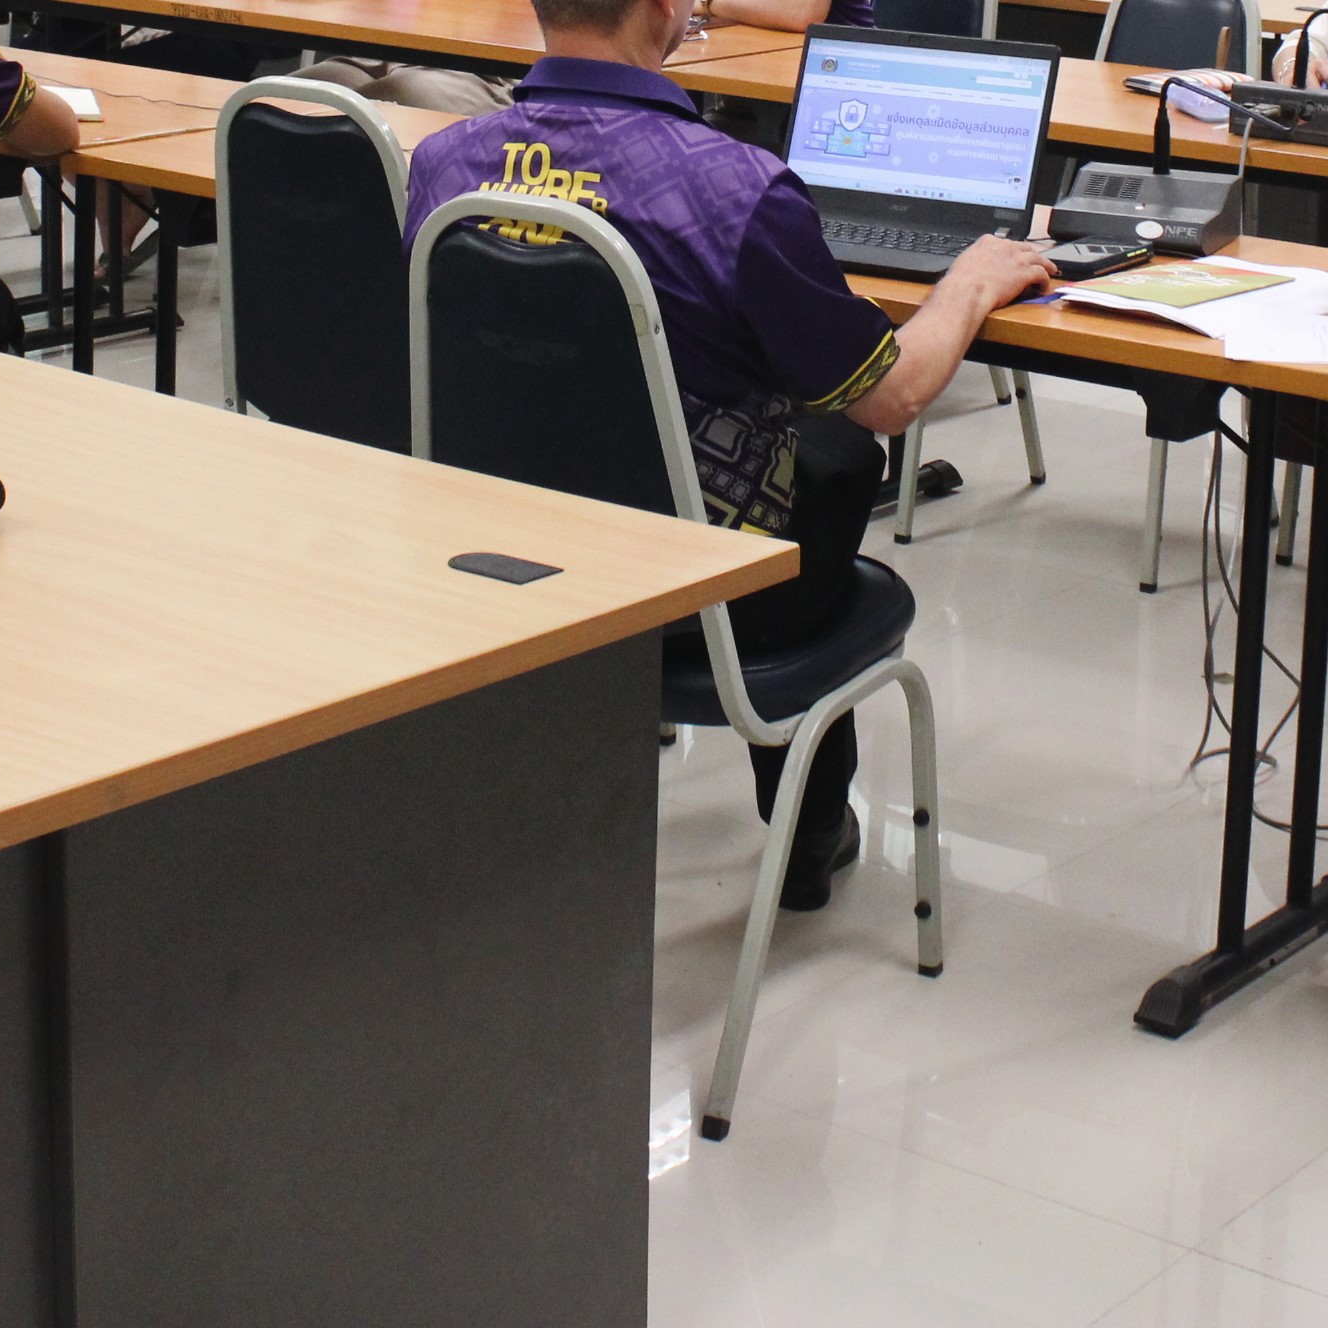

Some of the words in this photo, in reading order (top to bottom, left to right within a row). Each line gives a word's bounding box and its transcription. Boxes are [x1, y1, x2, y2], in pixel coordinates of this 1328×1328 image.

[886, 112, 1031, 139] แจ้งเหตุละเมิดข้อมูลส่วนบุคคล
[501, 142, 552, 185] TO
[1164, 224, 1199, 237] NPE
